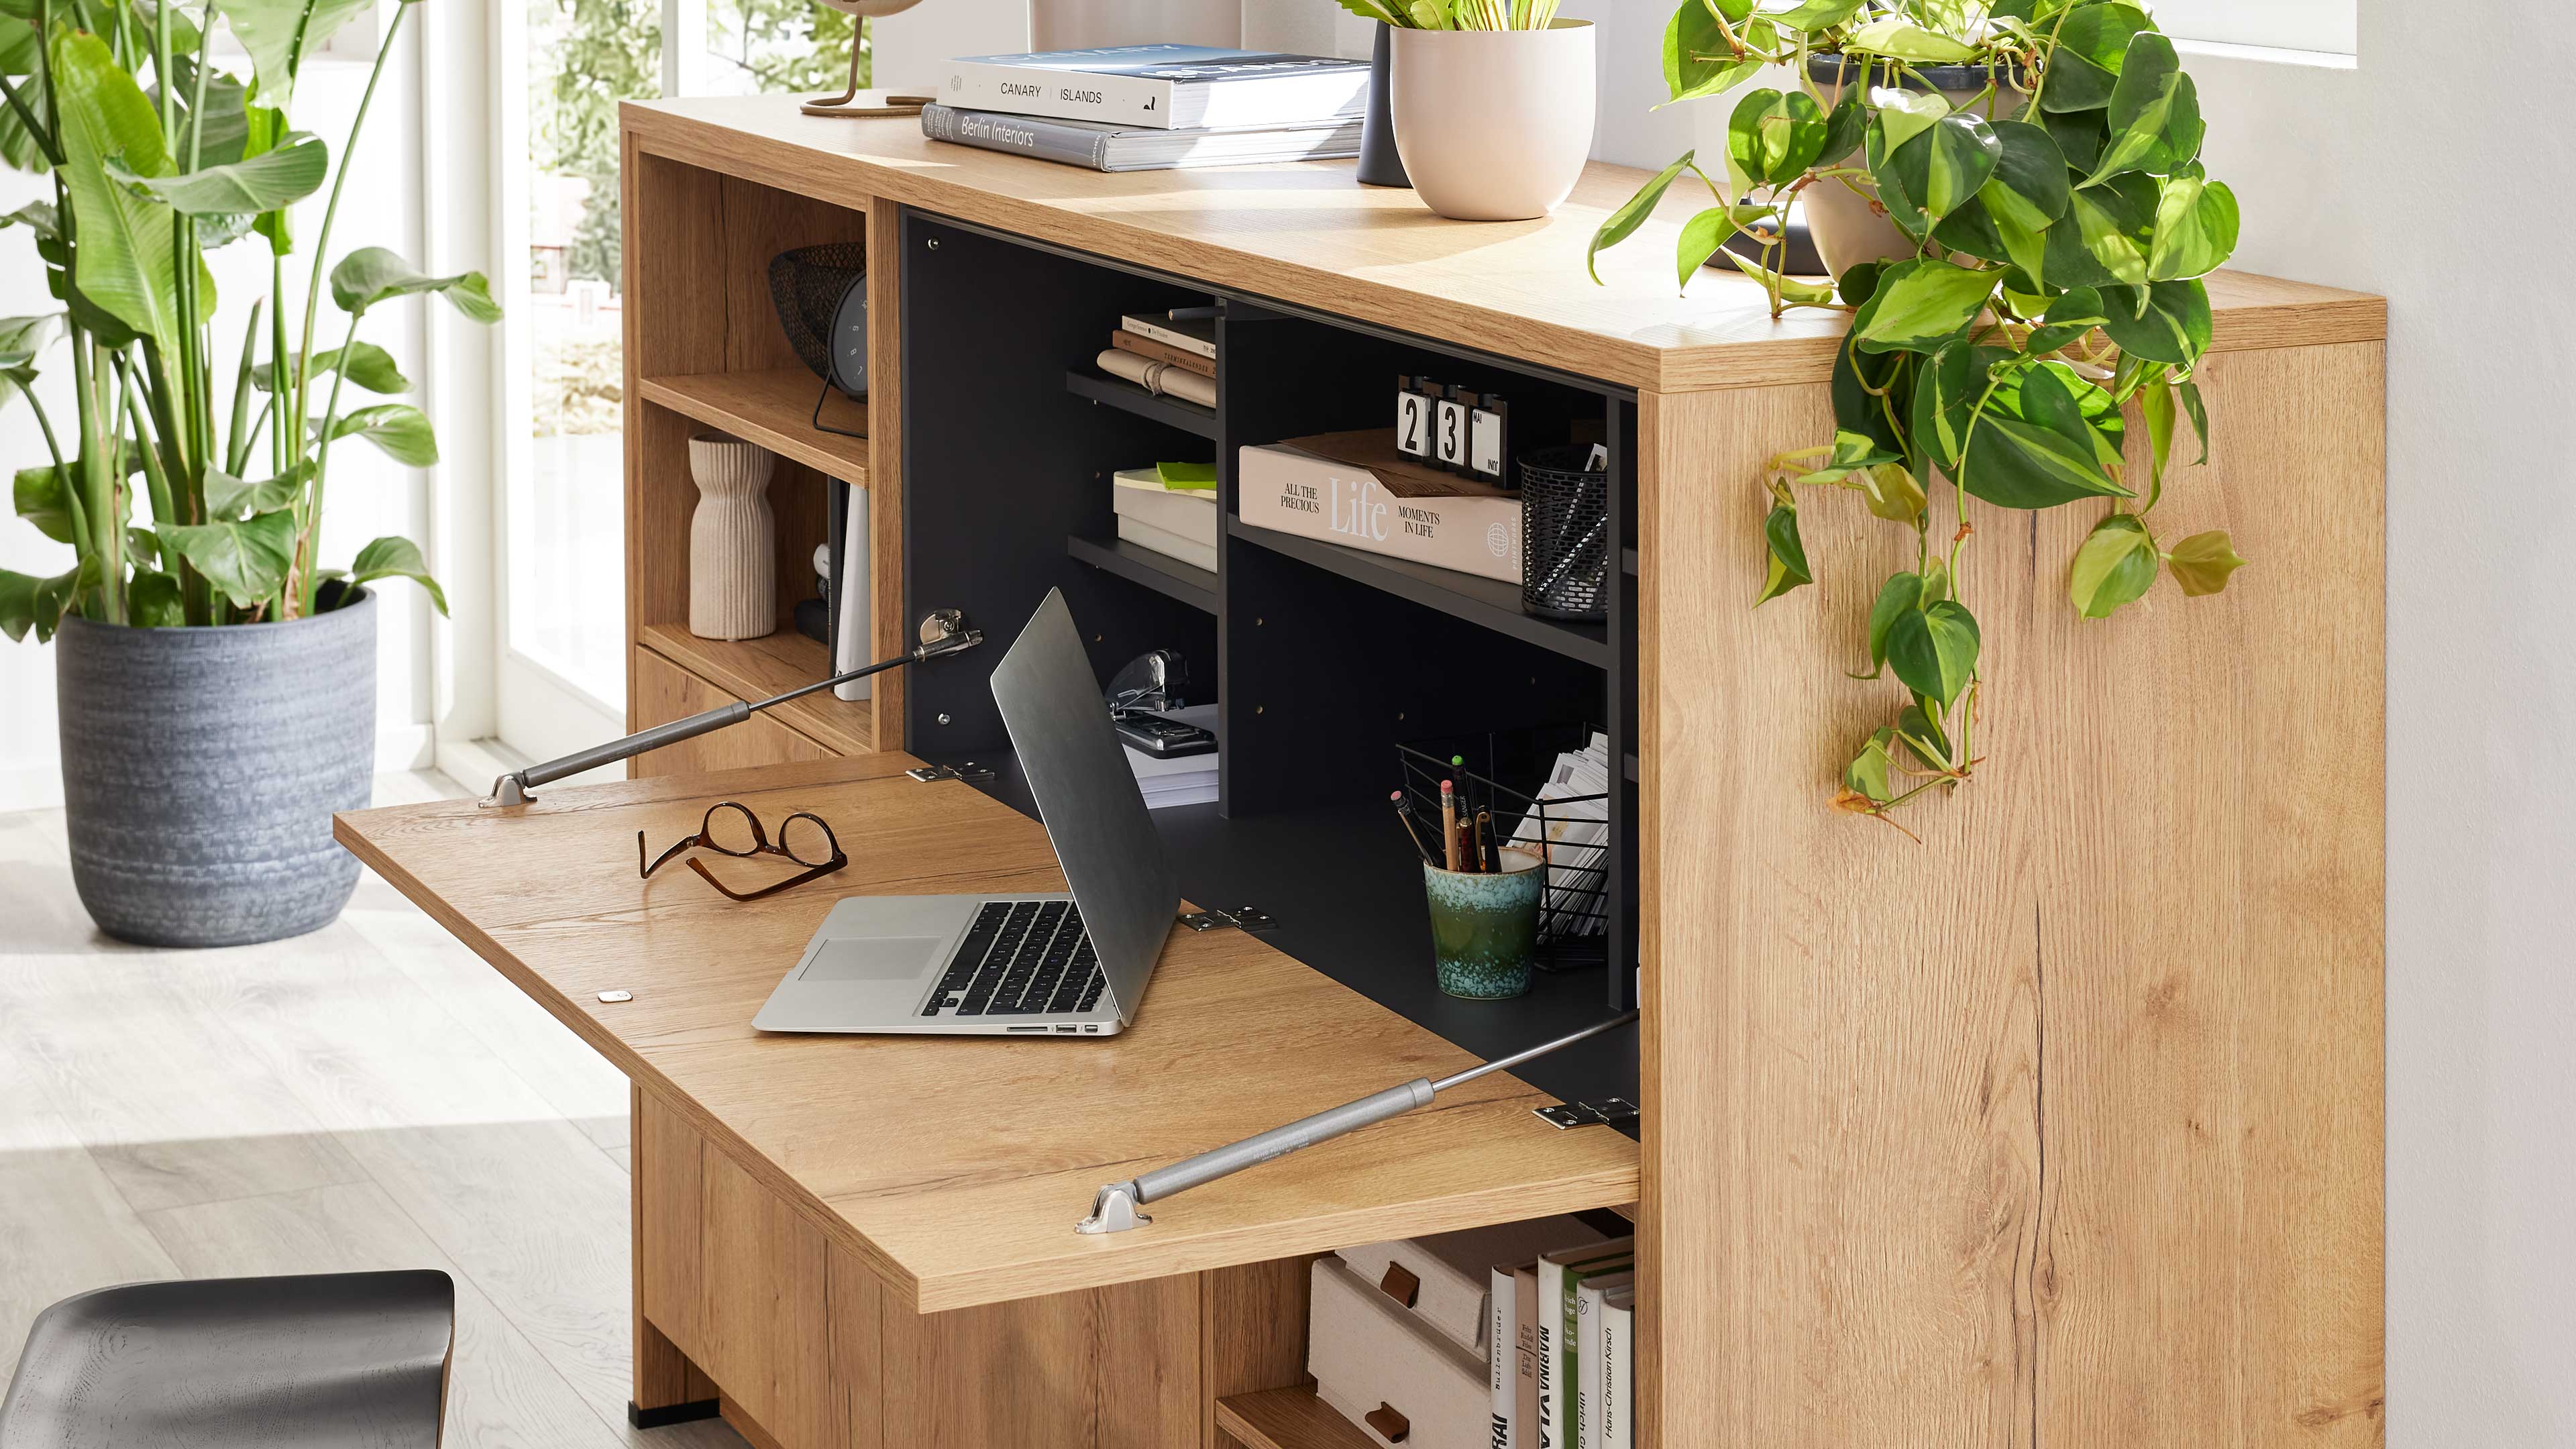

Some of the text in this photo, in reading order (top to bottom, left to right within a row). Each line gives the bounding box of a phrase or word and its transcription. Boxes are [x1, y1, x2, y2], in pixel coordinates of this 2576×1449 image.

[1000, 82, 1102, 104] CANARY ISLANDS
[961, 115, 989, 140] Berlin
[992, 121, 1034, 147] Interiors
[1092, 135, 1101, 166] TASCHEN
[1405, 398, 1417, 451] 2
[1472, 411, 1482, 423] MAI
[1444, 407, 1456, 460] 3
[1281, 495, 1320, 514] PRECIOUS
[1284, 483, 1318, 500] ALL THE
[1328, 477, 1389, 542] Life
[1398, 505, 1440, 525] MOMENTS
[1405, 521, 1434, 538] IN LIFE
[1540, 1325, 1550, 1391] MARINA
